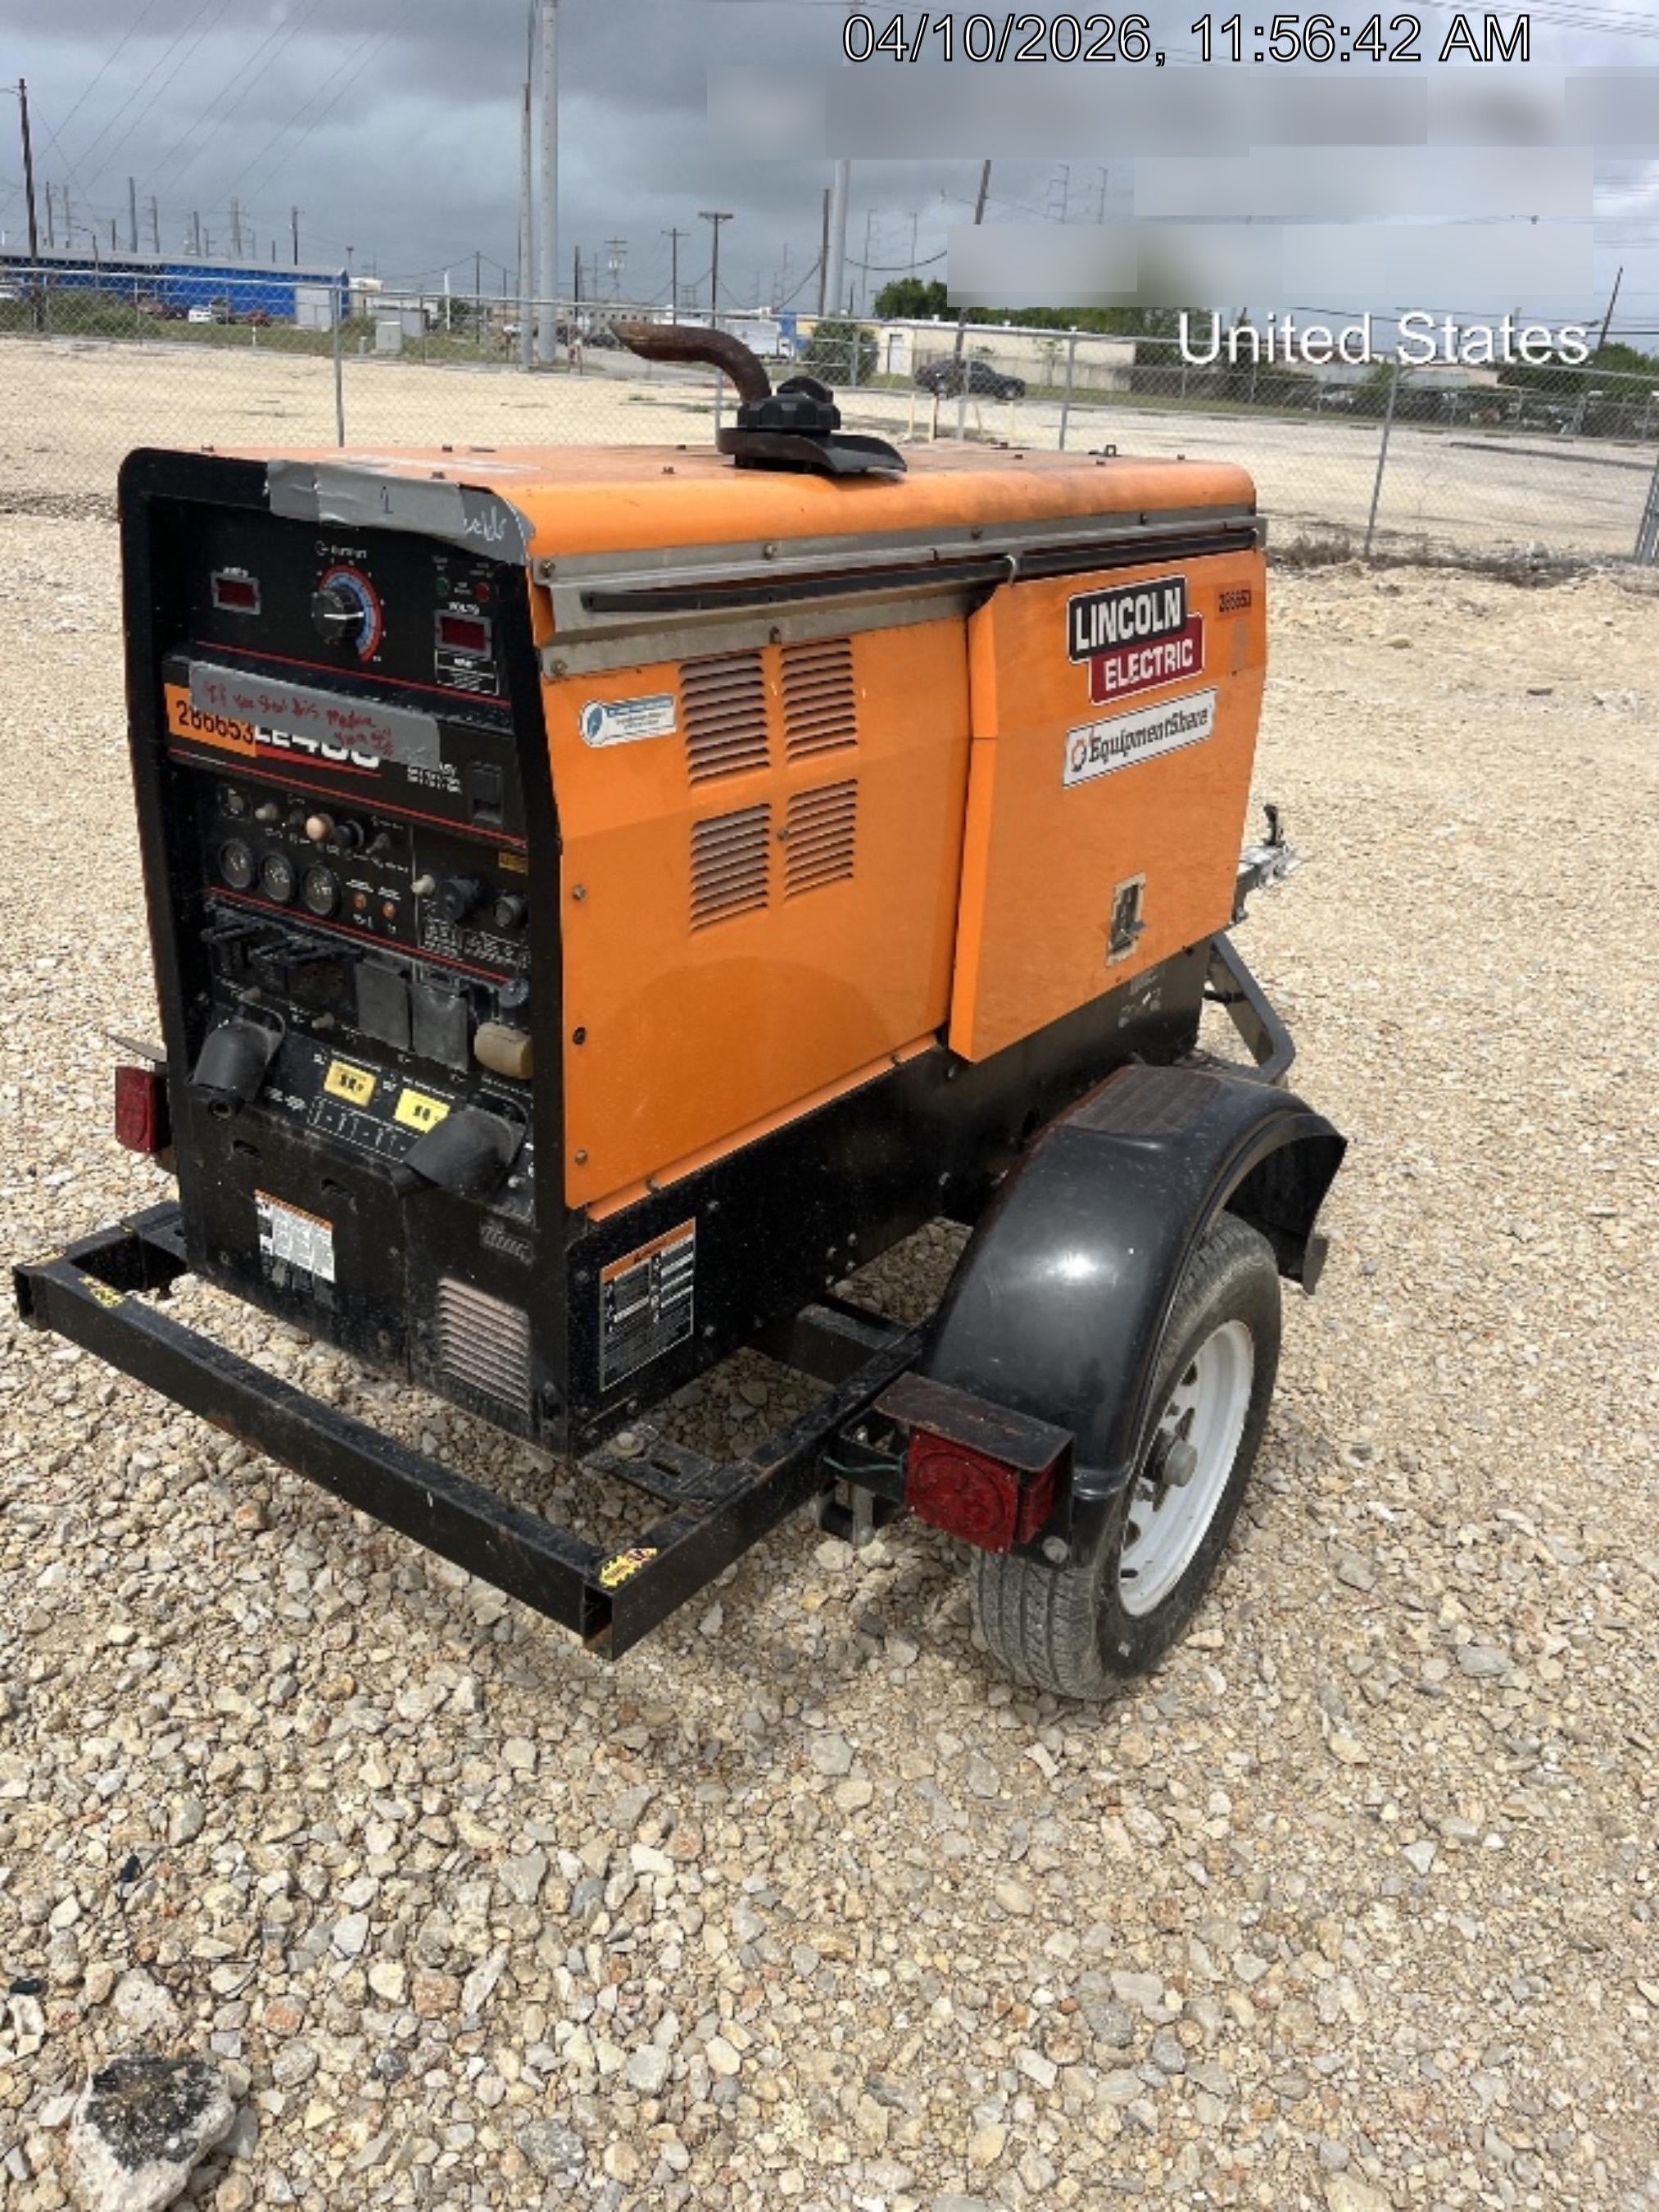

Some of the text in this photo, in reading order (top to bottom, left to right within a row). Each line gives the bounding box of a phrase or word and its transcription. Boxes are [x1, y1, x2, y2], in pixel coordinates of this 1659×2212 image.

[1075, 587, 1181, 651] LINCOLN
[1103, 638, 1194, 691] ELECTRIC
[1089, 708, 1209, 764] EquipmentShare
